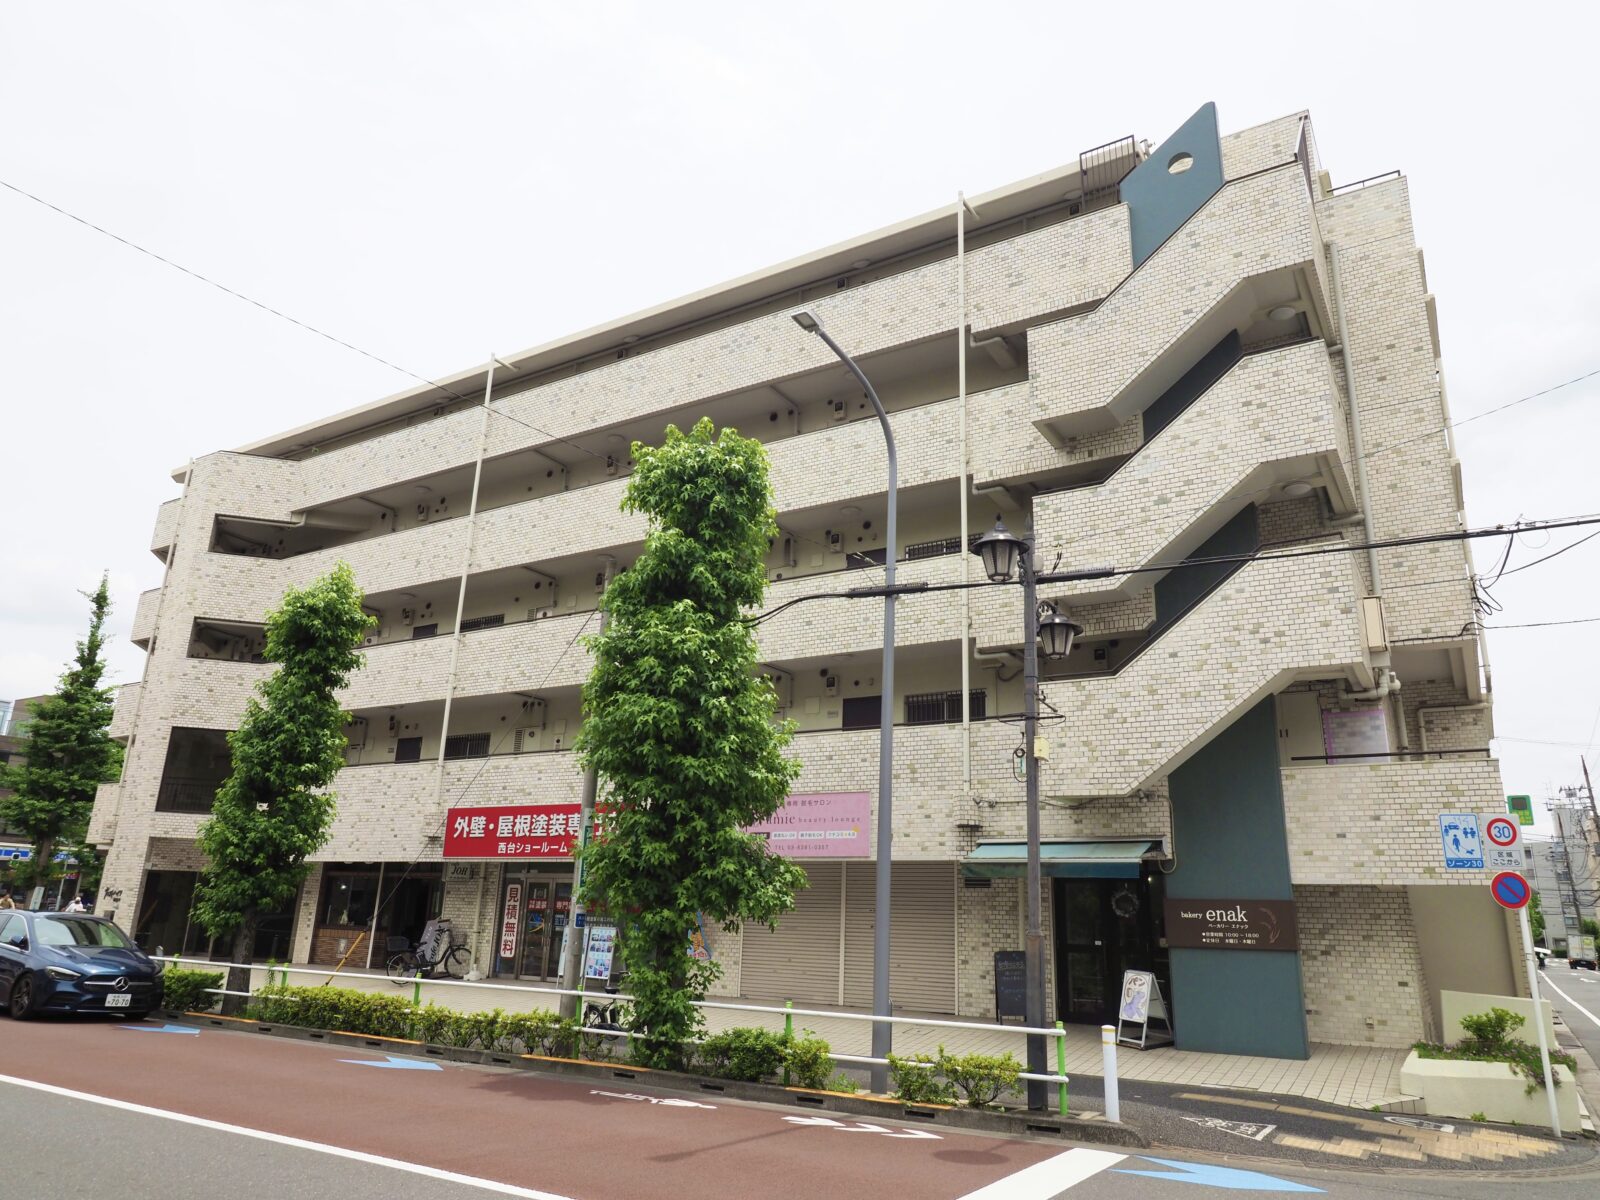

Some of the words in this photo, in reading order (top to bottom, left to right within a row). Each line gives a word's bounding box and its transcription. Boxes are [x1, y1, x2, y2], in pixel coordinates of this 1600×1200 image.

[1493, 825, 1511, 839] 30
[498, 841, 568, 854] 西台ショールーム
[1492, 858, 1521, 866] ここから
[1180, 911, 1203, 920] bakery
[1205, 905, 1248, 922] enak
[502, 887, 519, 955] 見積無料
